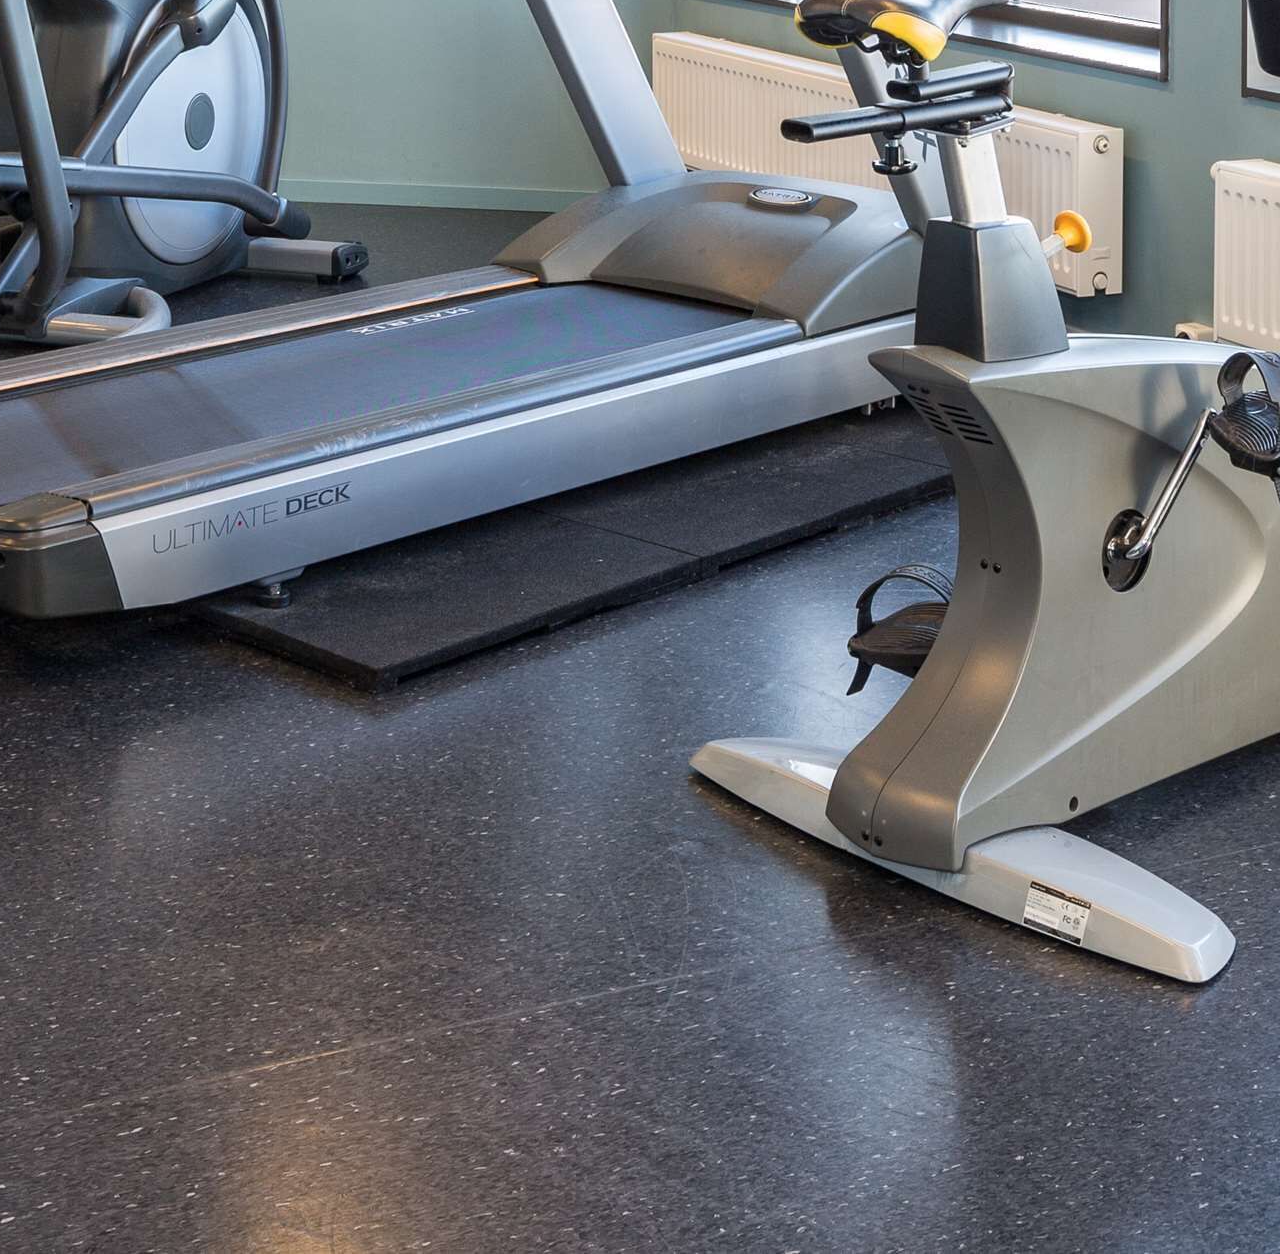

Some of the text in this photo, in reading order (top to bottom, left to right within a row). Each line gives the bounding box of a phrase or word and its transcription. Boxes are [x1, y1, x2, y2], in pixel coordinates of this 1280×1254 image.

[351, 307, 470, 334] MATRIX
[152, 483, 351, 555] ULTIMATE DECK
